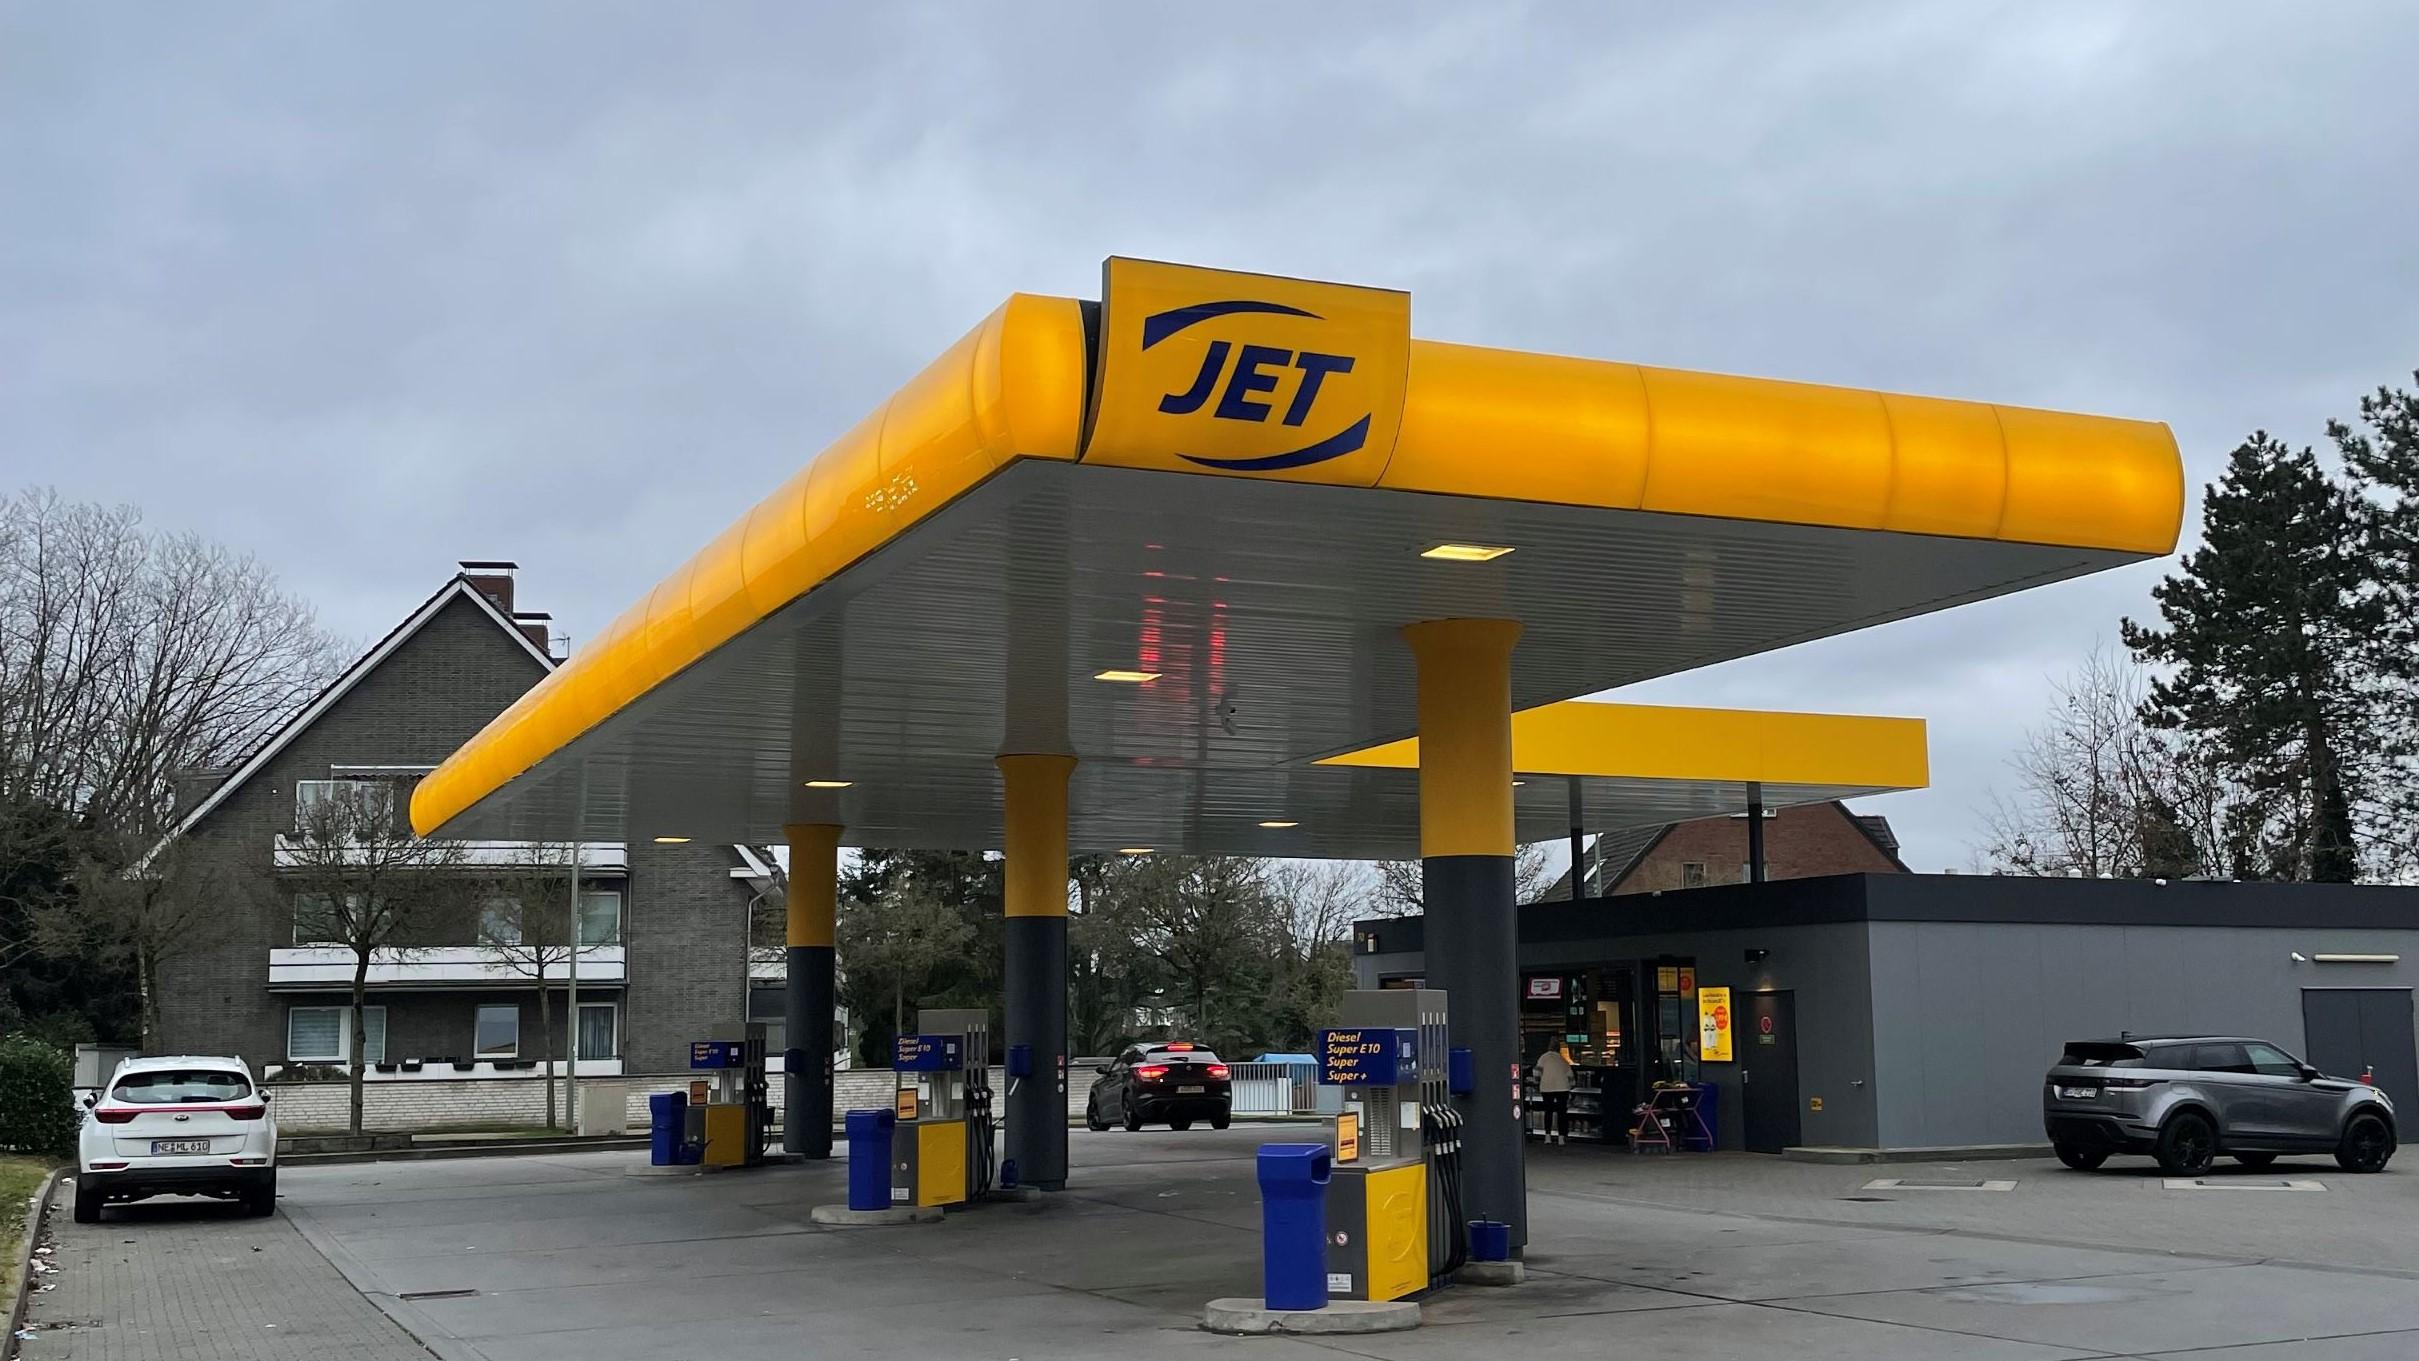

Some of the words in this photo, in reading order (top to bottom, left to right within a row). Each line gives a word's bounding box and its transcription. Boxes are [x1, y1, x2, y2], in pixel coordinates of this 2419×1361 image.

[1158, 340, 1355, 426] JET
[1327, 1031, 1361, 1042] Diesel
[1327, 1044, 1359, 1056] Super
[1327, 1057, 1359, 1069] Super
[1327, 1071, 1359, 1083] Super
[190, 1141, 208, 1151] 610
